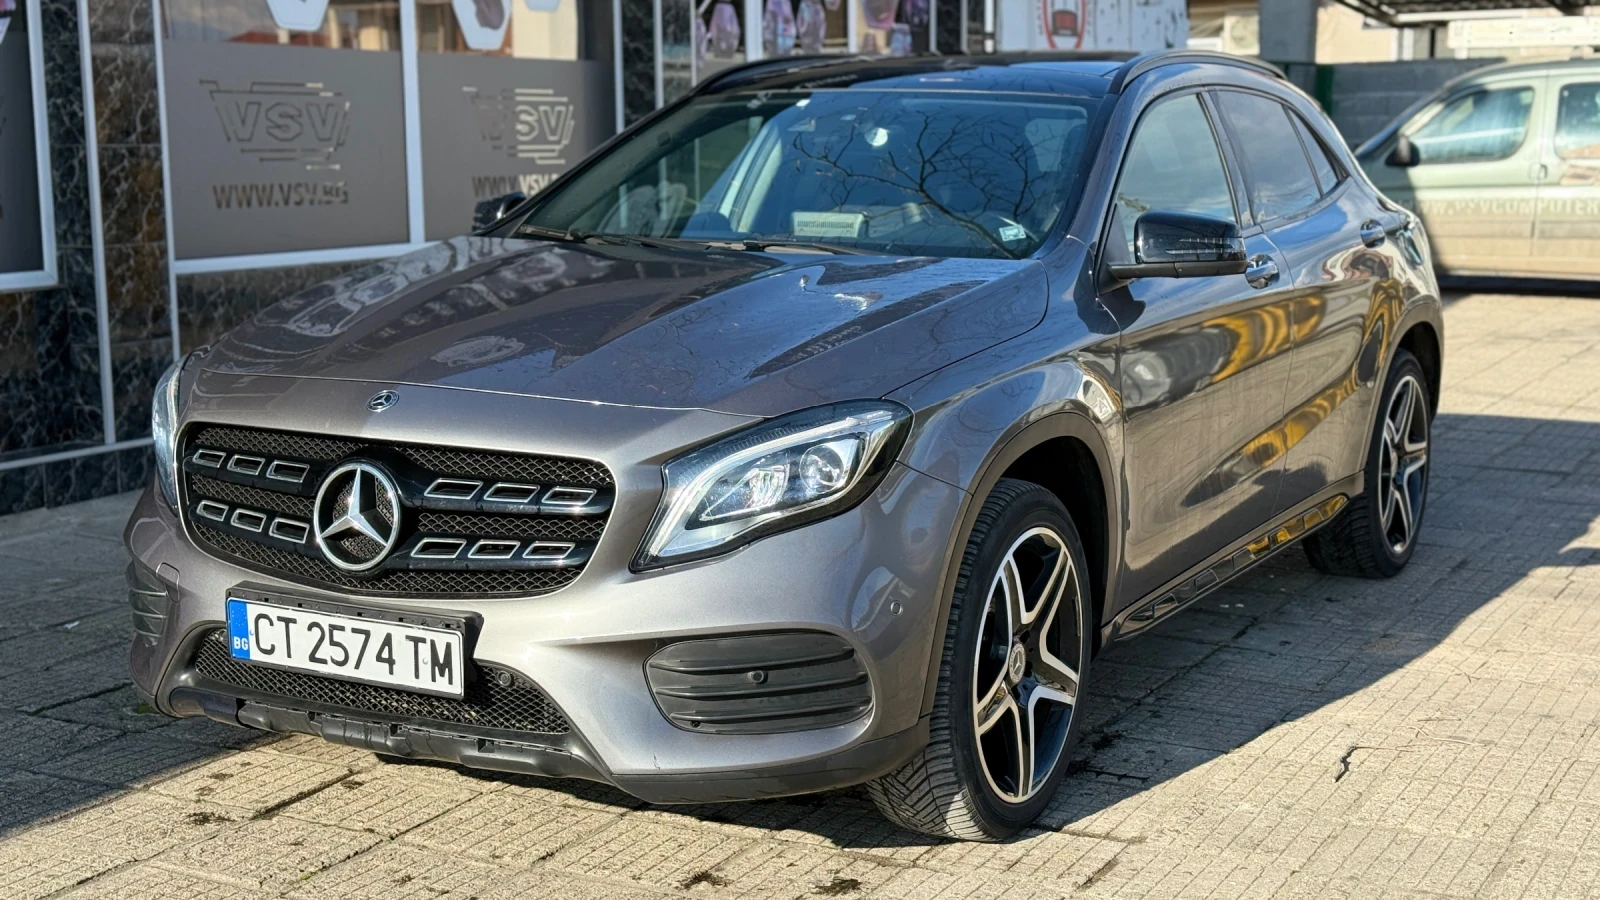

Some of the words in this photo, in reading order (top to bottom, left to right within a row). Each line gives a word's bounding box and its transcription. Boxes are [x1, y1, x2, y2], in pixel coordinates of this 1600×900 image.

[220, 101, 340, 142] VSV
[233, 636, 249, 650] BG
[254, 613, 297, 658] CT
[307, 621, 396, 675] 2574
[405, 635, 453, 685] TM
